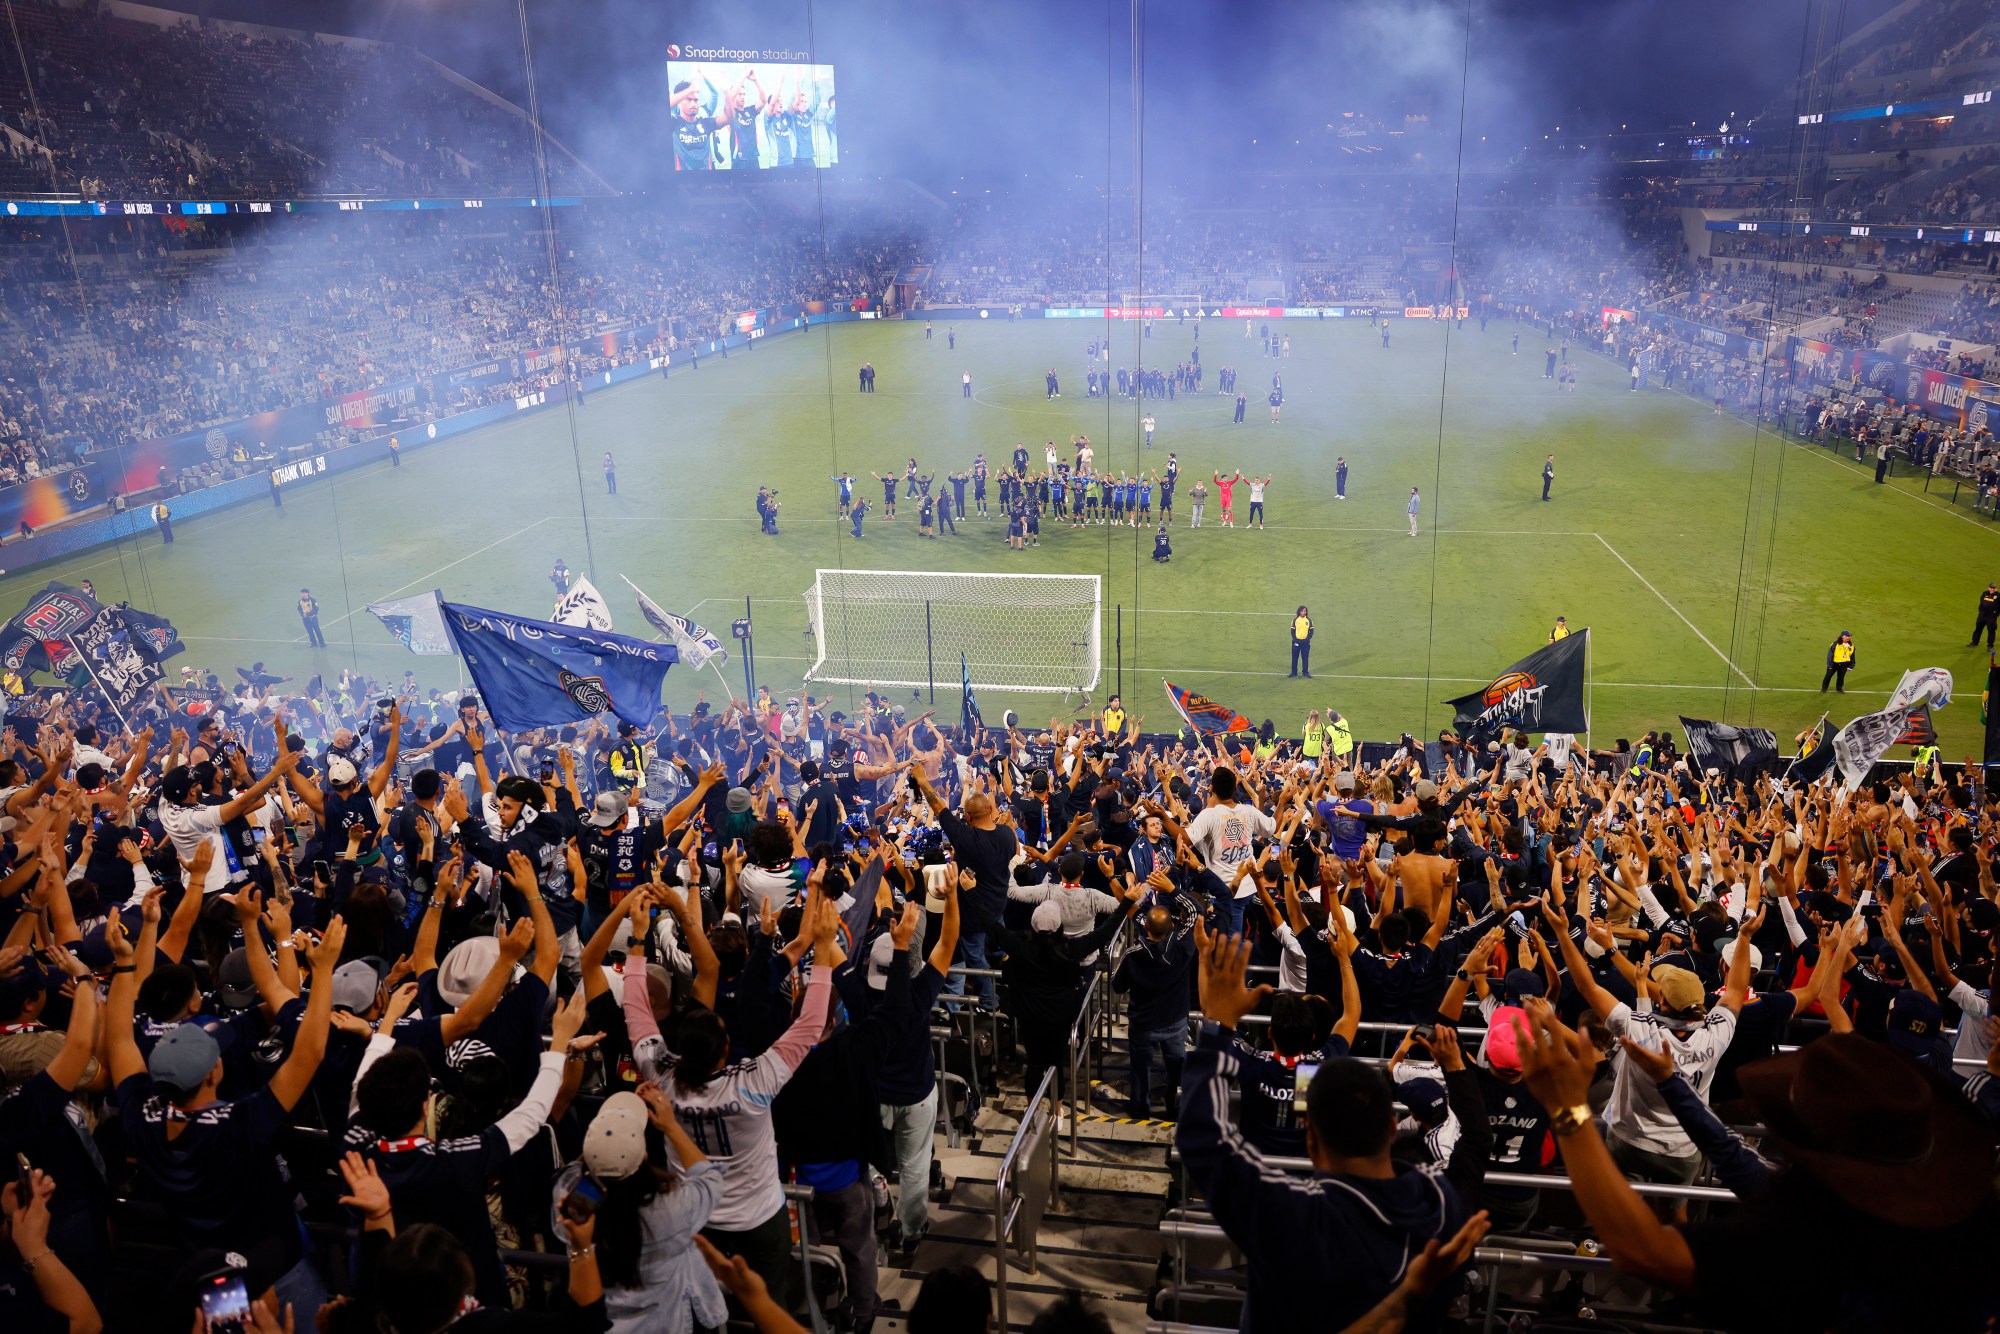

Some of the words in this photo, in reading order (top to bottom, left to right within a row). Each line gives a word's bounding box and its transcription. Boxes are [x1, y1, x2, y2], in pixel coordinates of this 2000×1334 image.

[685, 45, 759, 61] Snapdragon
[762, 48, 809, 60] stadium
[123, 203, 136, 214] SAN
[136, 203, 153, 214] DIEGO
[167, 203, 172, 214] 2
[234, 203, 238, 213] 1
[250, 203, 271, 213] PORTLAND
[1928, 381, 1945, 404] SAN
[1944, 385, 1969, 410] DIEGO
[326, 406, 342, 424] SAN
[343, 399, 364, 420] DIEGO
[399, 387, 416, 404] CLUB
[276, 463, 299, 484] THANK
[299, 459, 316, 476] YOU,
[316, 456, 326, 472] SD
[1309, 734, 1321, 742] 103
[617, 836, 634, 846] SD
[616, 846, 634, 857] FC
[1220, 844, 1251, 864] SDFC
